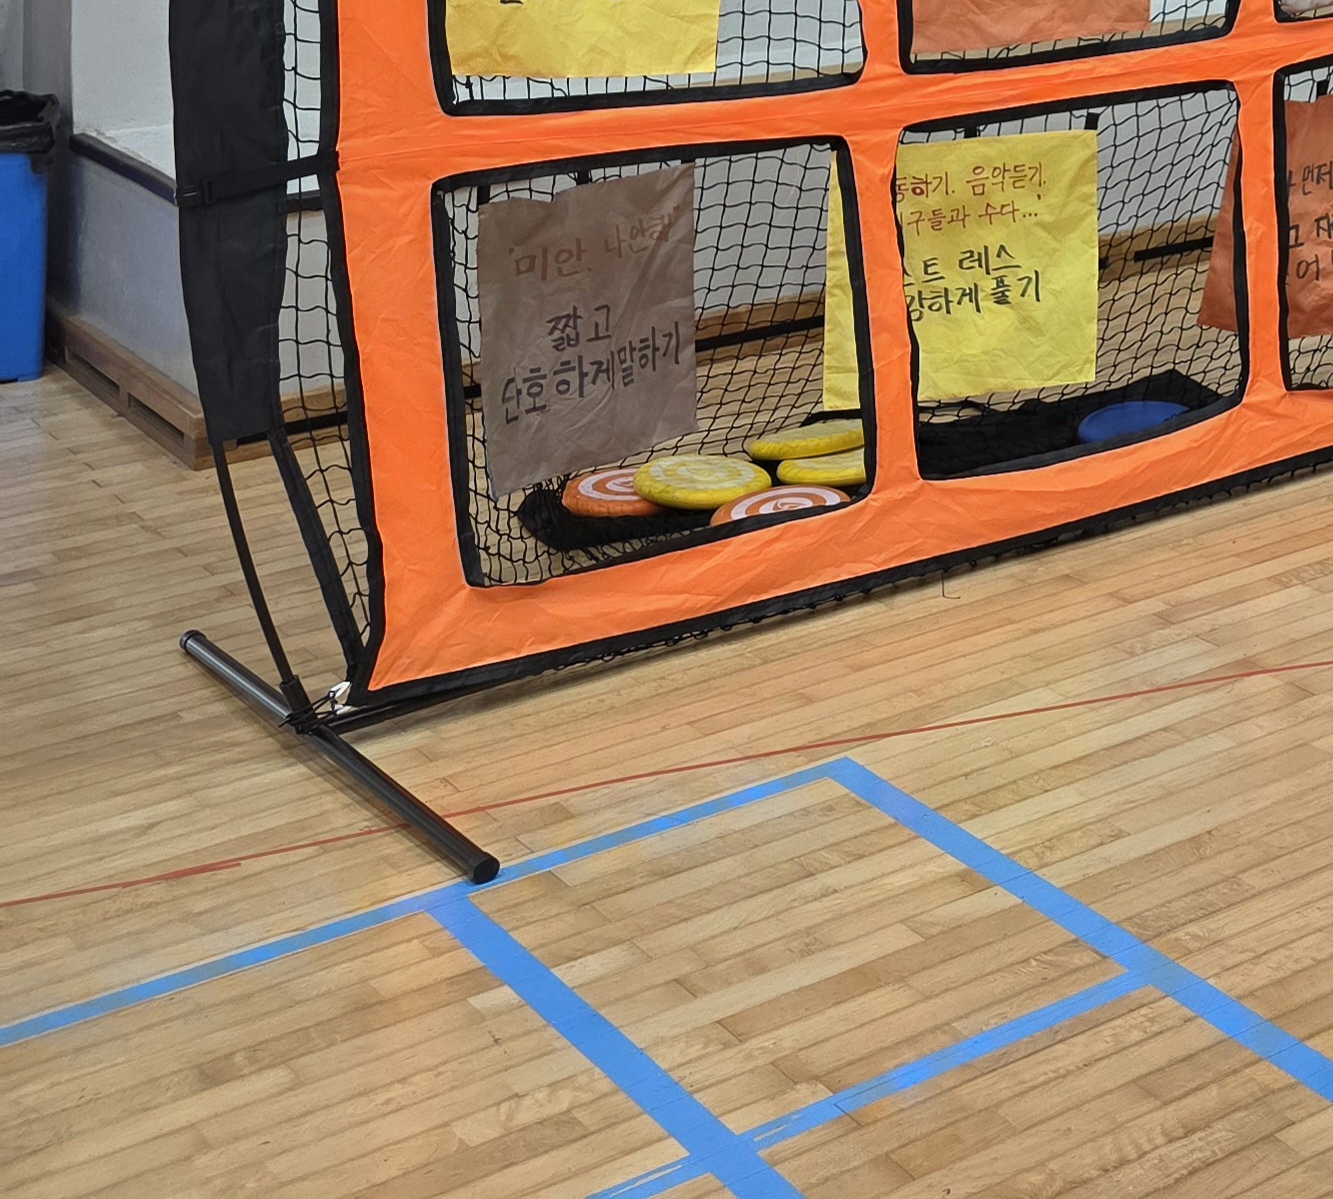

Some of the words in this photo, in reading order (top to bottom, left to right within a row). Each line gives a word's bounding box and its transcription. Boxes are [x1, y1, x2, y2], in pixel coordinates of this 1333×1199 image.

[896, 172, 955, 202] 동하기.
[1302, 161, 1333, 196] 먼저
[905, 282, 981, 322] 강하게
[990, 269, 1041, 306] 풀기
[545, 304, 612, 352] 짧고
